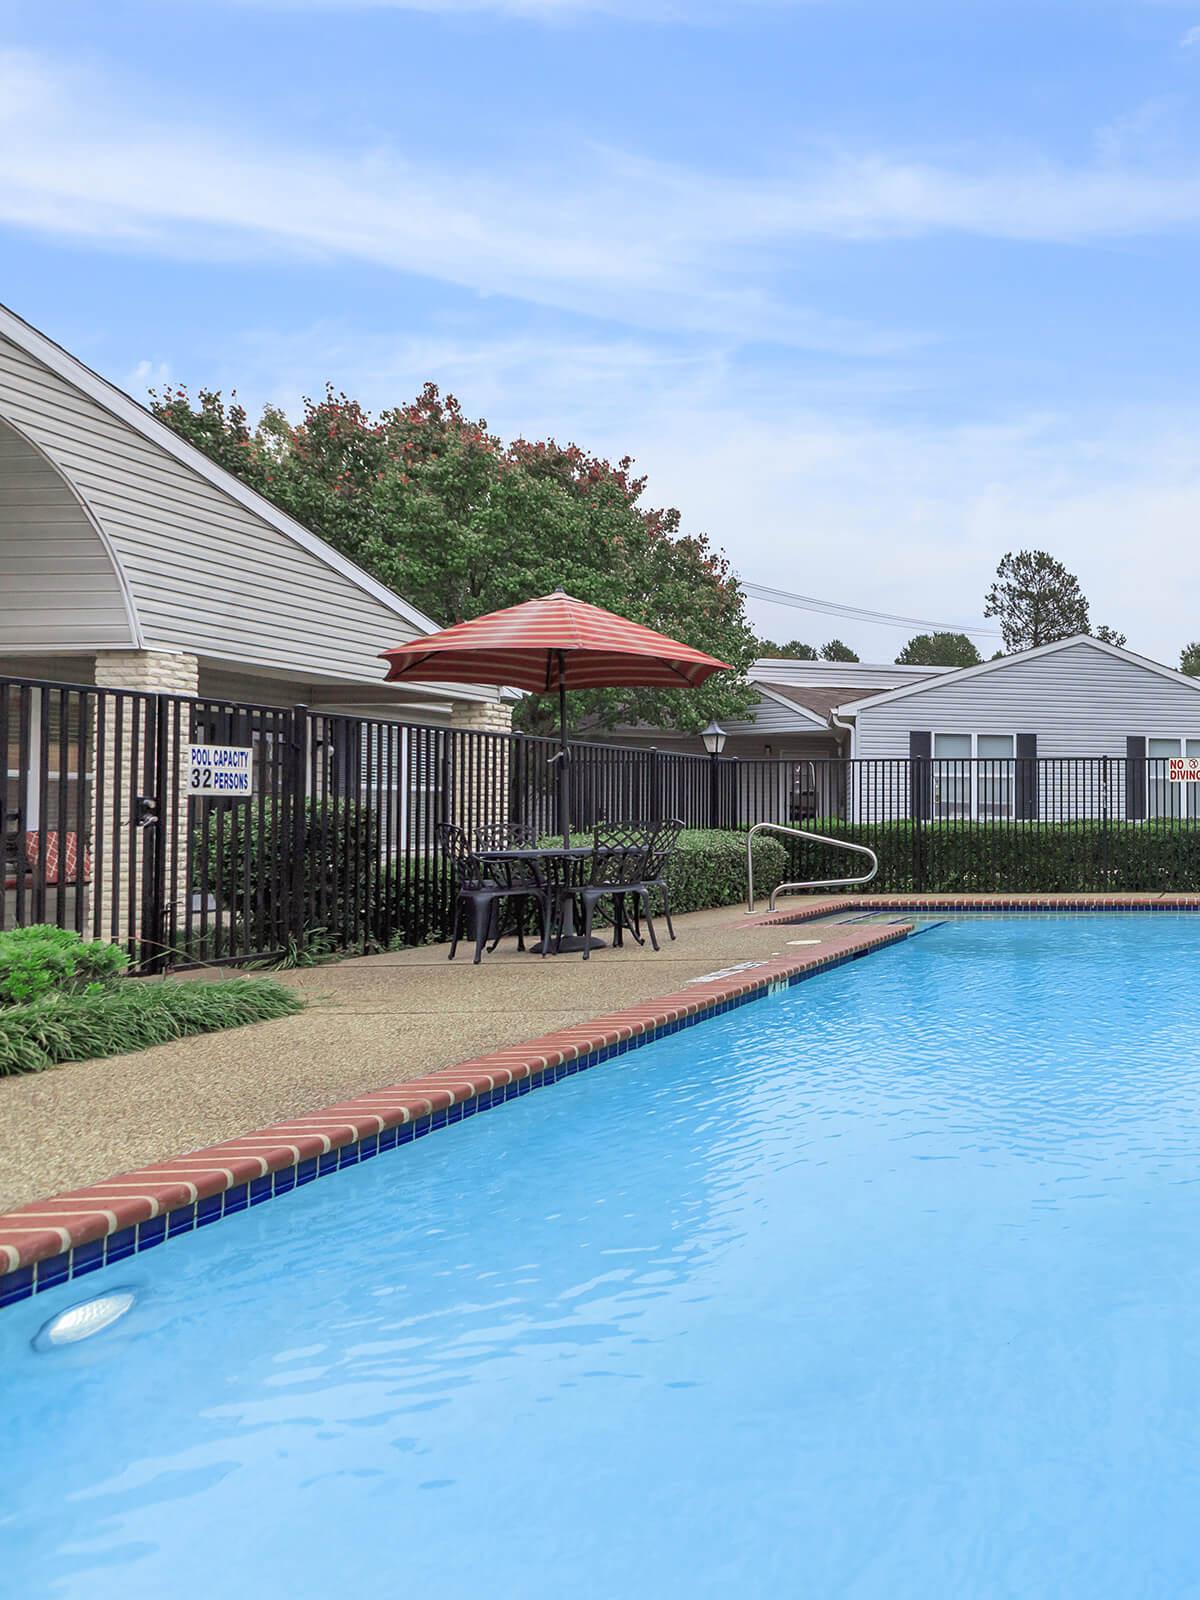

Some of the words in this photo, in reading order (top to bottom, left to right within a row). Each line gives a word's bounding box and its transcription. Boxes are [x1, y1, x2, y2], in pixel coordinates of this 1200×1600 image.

[191, 748, 211, 766] POOL
[213, 750, 248, 768] CAPACITY
[1170, 759, 1184, 769] NO
[191, 768, 212, 789] 32
[214, 772, 248, 790] PERSONS
